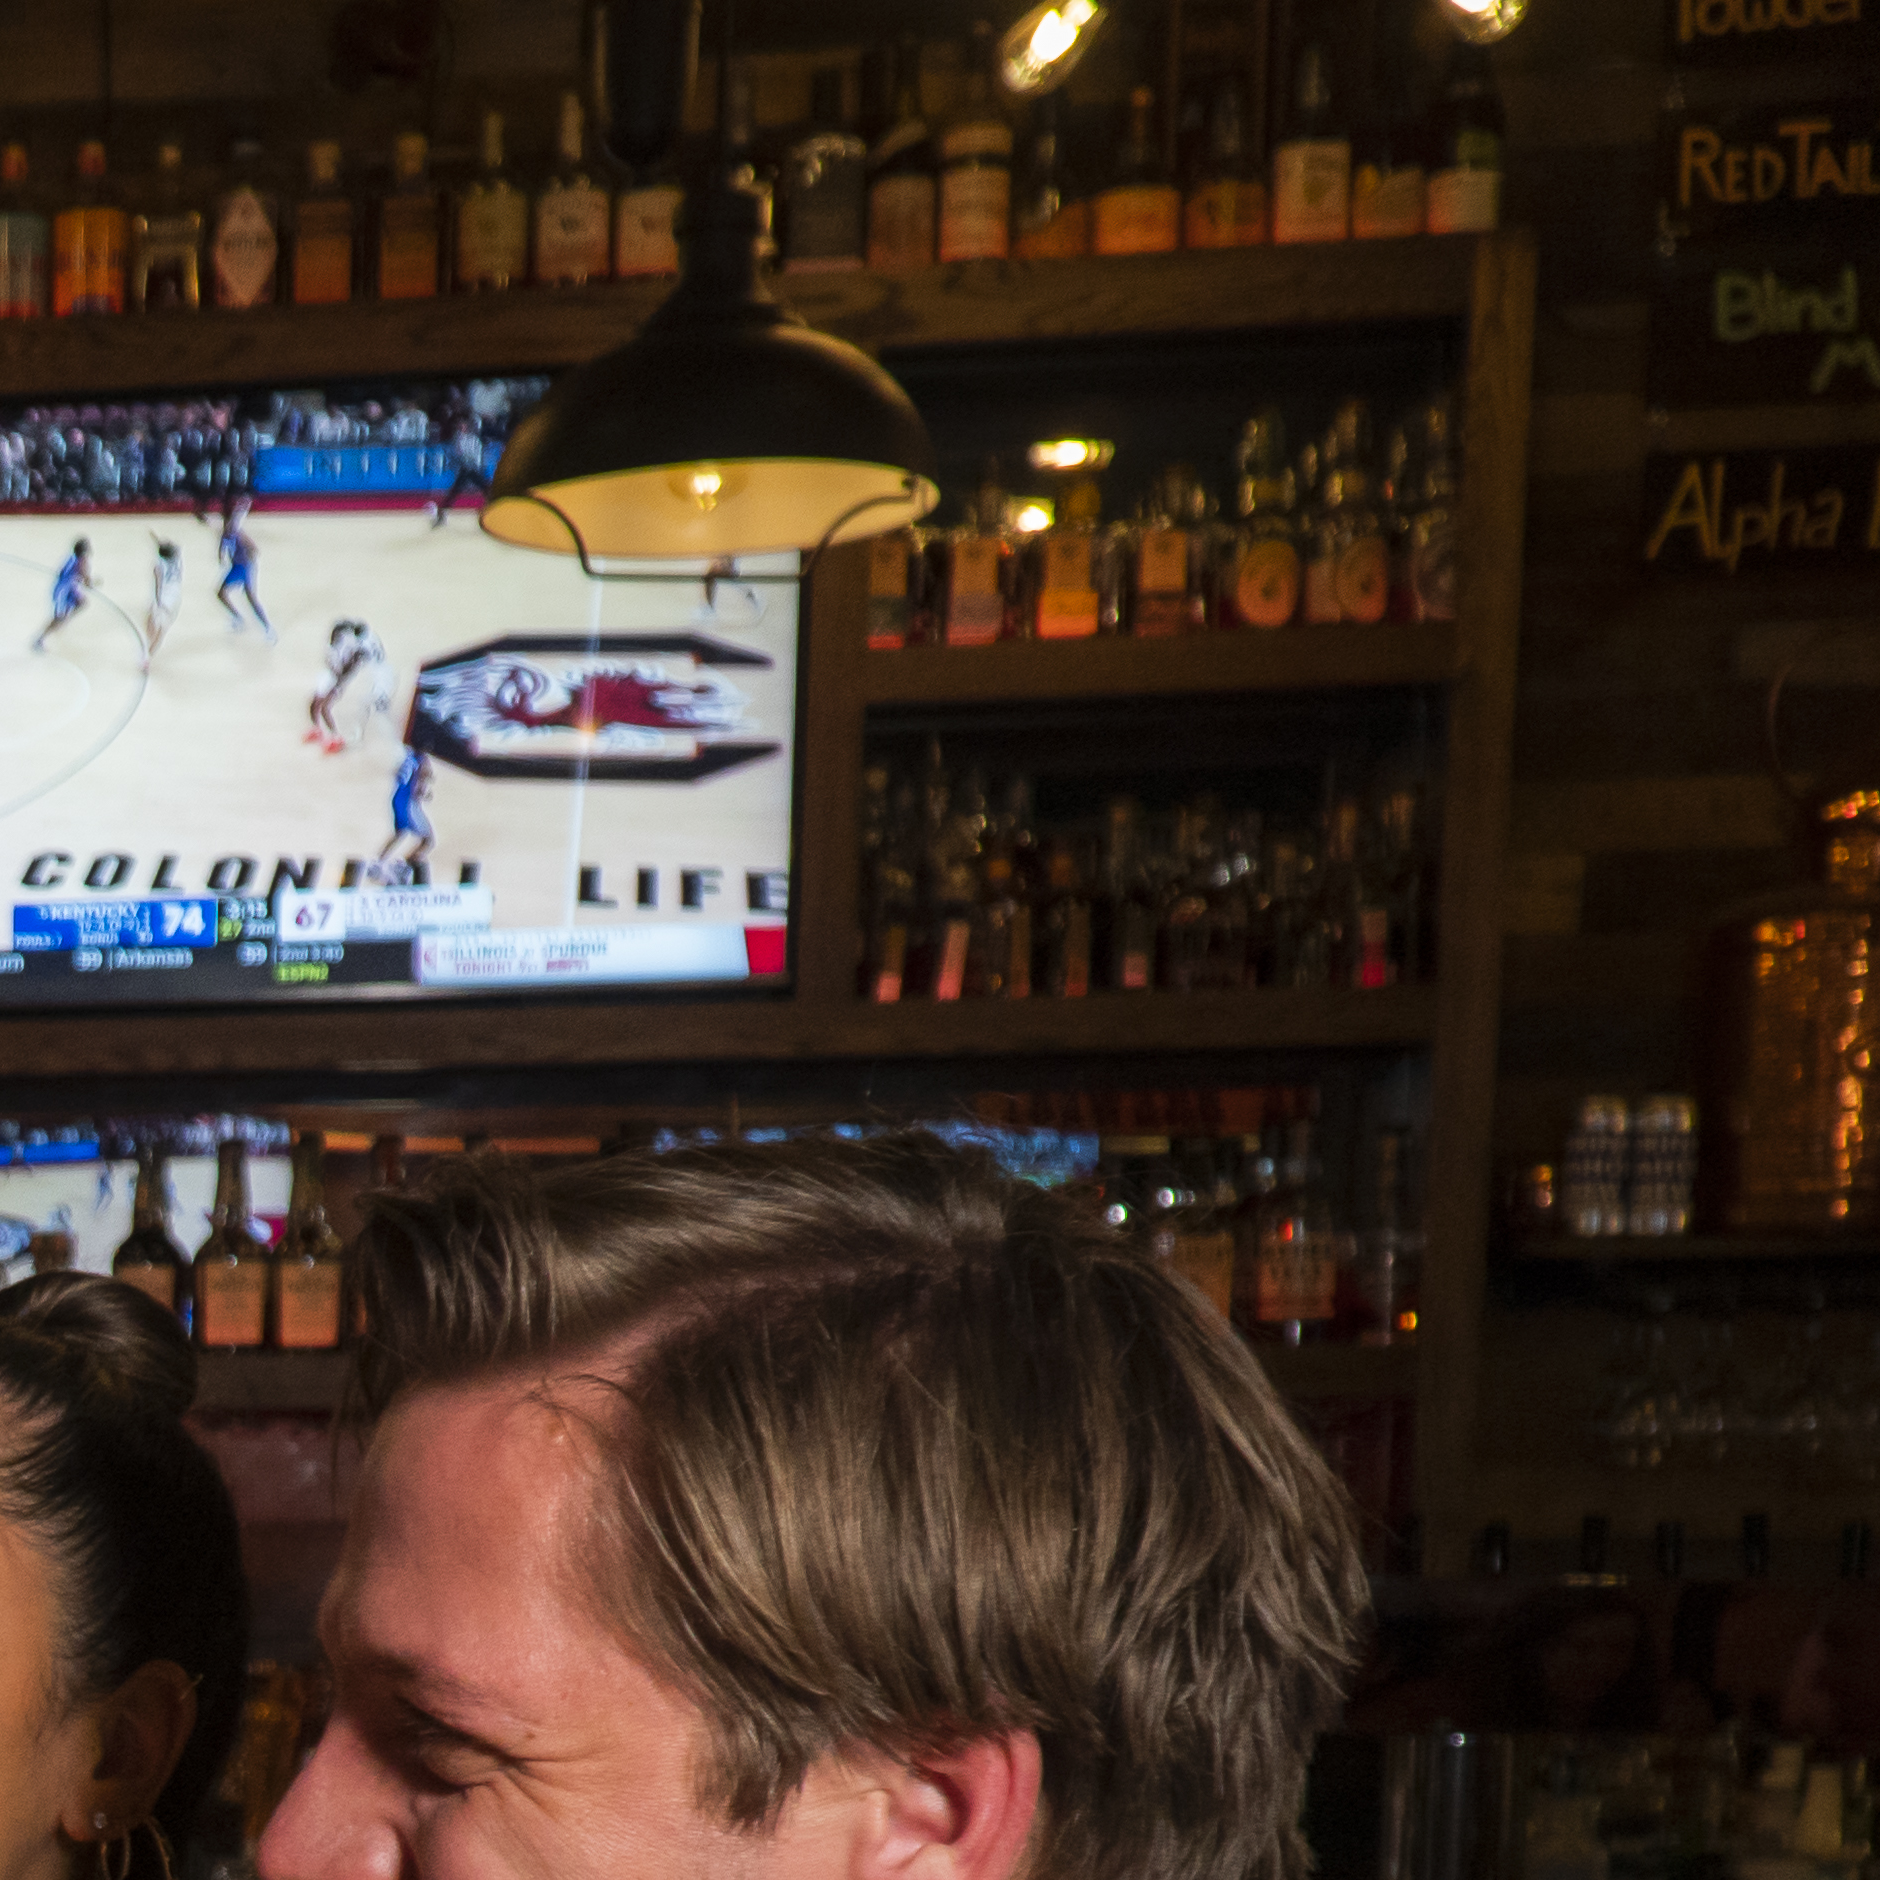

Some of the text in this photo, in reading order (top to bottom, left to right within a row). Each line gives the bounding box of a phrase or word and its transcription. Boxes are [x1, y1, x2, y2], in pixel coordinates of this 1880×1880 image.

[1647, 458, 1842, 573] Alpha
[21, 851, 789, 914] COLONI LIFE
[161, 902, 206, 938] 74
[294, 901, 333, 931] 67
